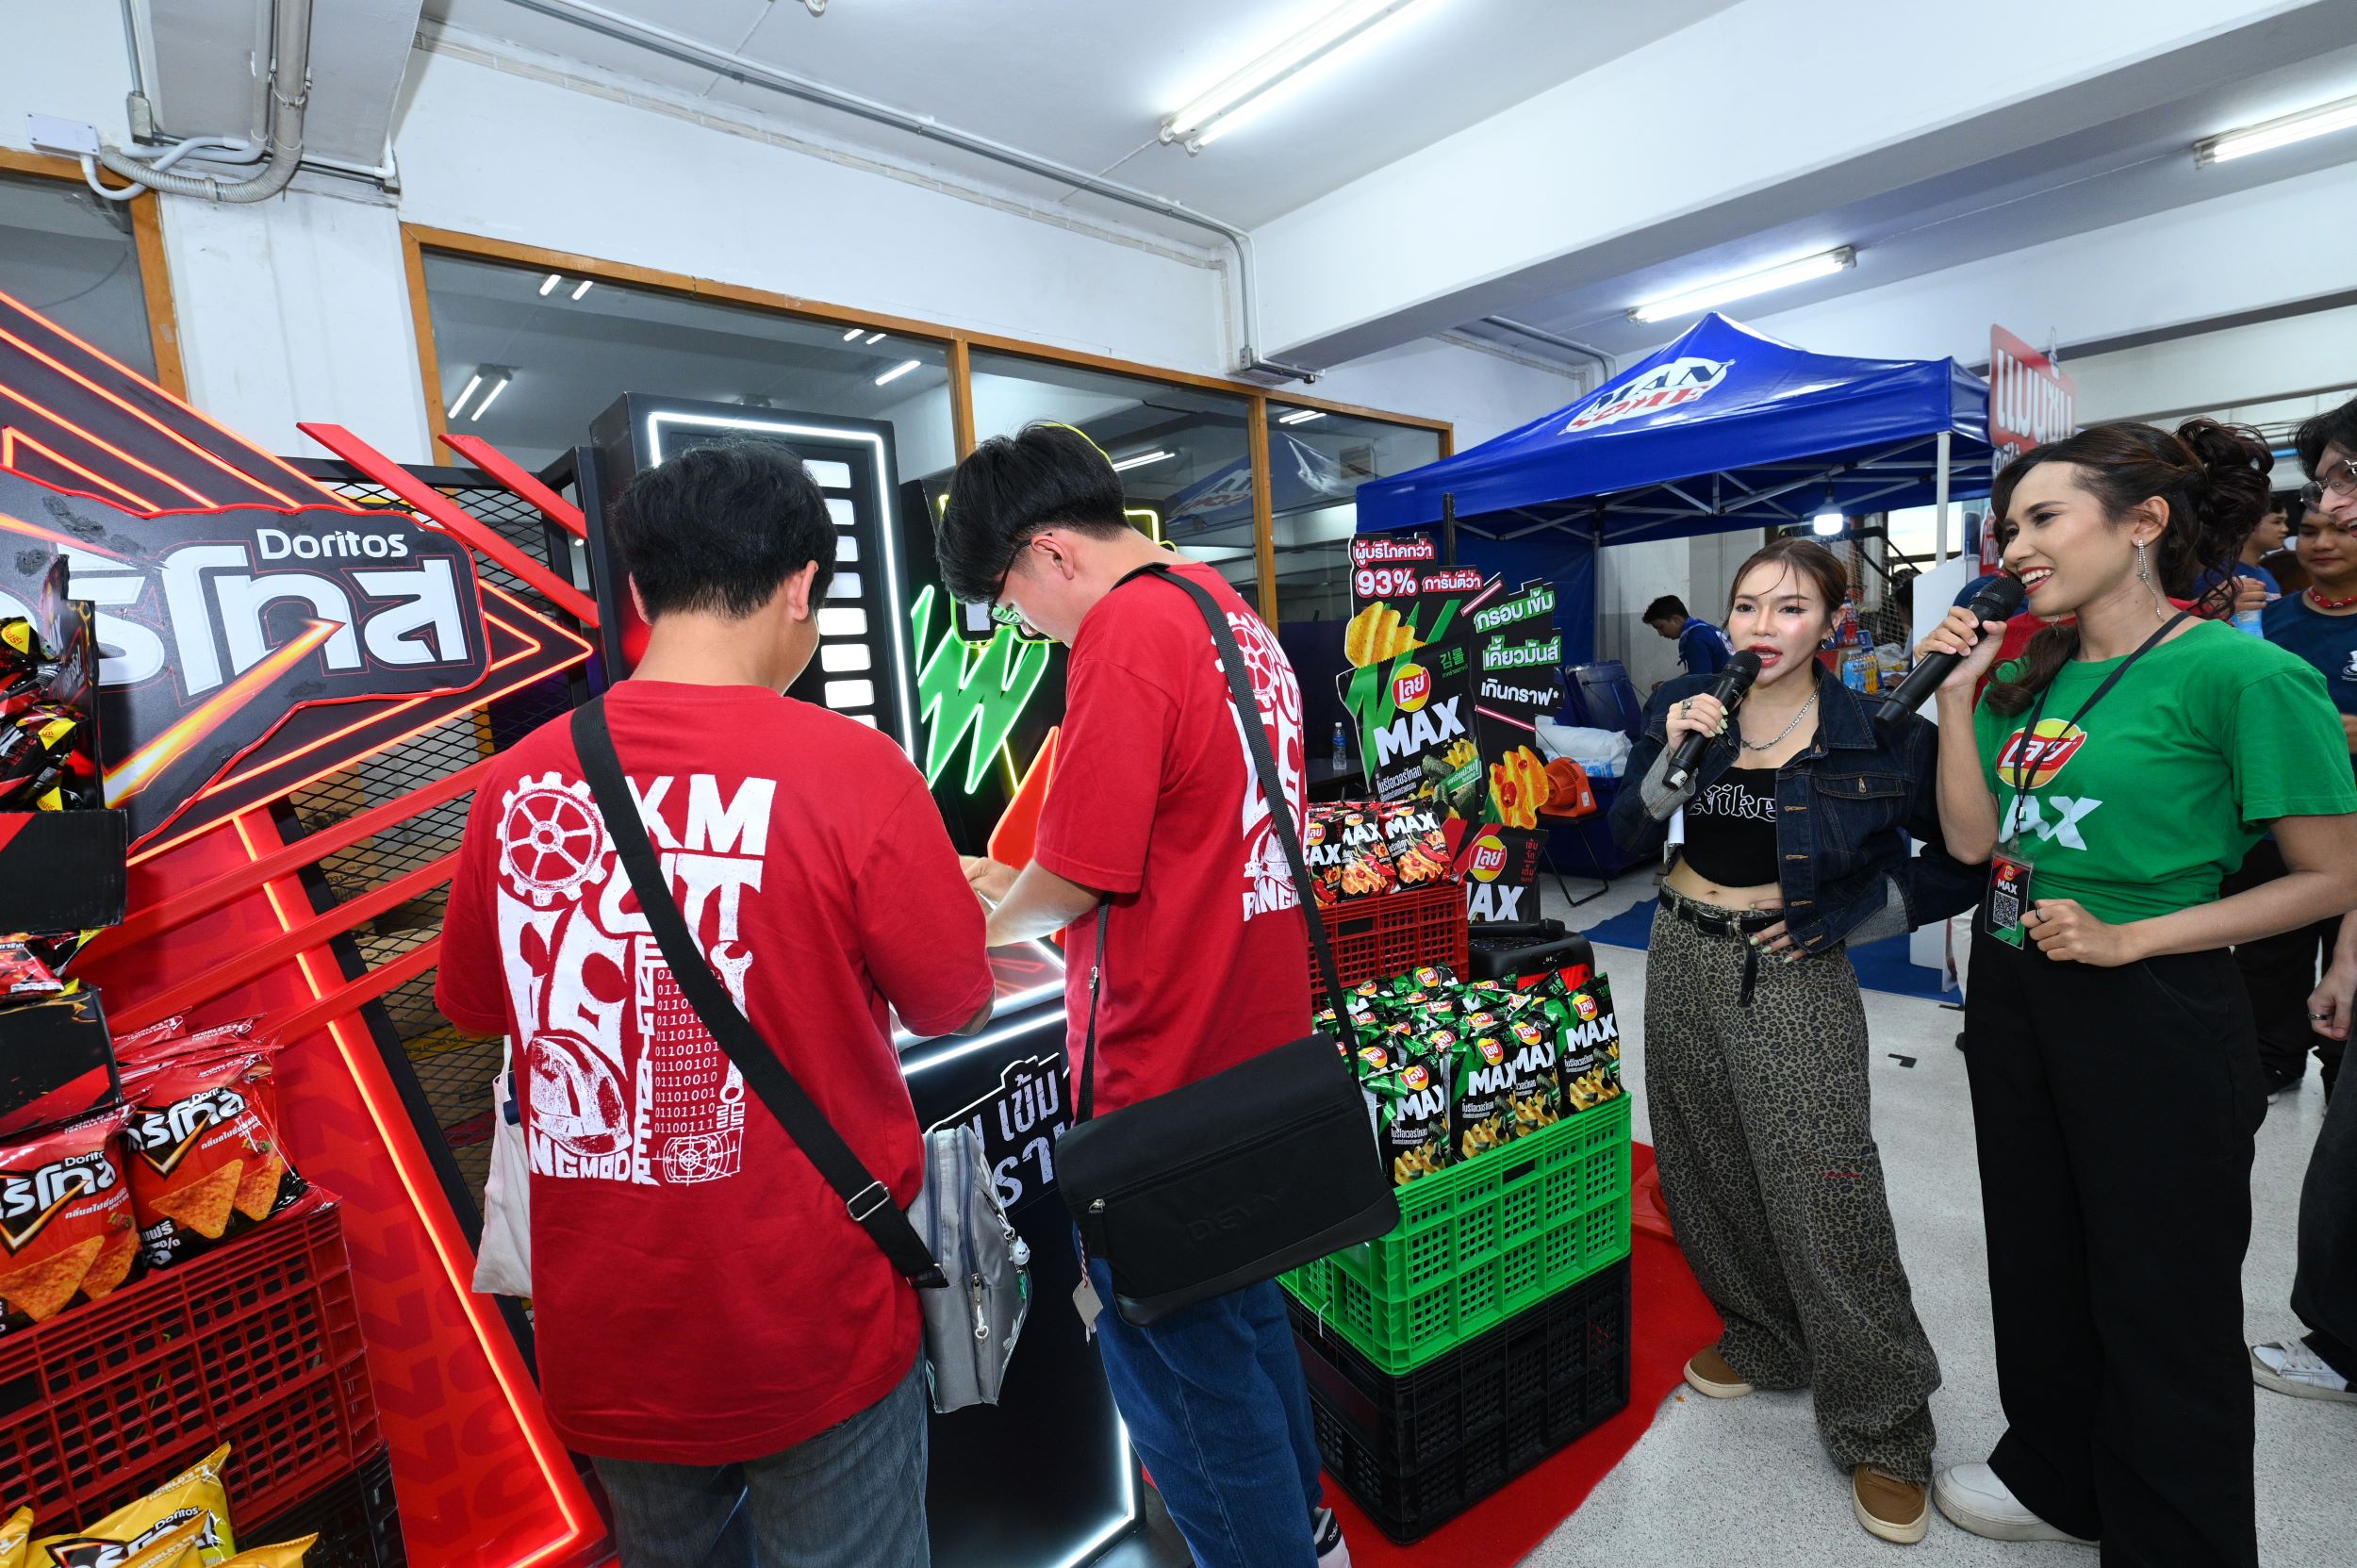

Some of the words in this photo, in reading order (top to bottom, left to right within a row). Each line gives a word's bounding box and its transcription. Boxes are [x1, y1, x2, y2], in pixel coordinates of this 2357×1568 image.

[1586, 364, 1725, 414] MAN
[256, 528, 409, 561] Doritos
[1355, 540, 1432, 565] ผู้บริโภคกว่า
[1358, 569, 1416, 596] 93%
[1425, 571, 1481, 591] การันตีว่า
[1477, 603, 1524, 631] กรอบ
[1526, 590, 1554, 619] เข้ม
[1485, 635, 1560, 668] เคี้ยวมันส์
[1374, 695, 1466, 767] MAX
[625, 773, 777, 857] KM
[1385, 812, 1439, 839] MAX
[1999, 795, 2103, 850] AX
[1310, 844, 1342, 866] AX
[1997, 879, 2018, 895] MAX
[1467, 883, 1525, 921] AX
[1566, 1014, 1618, 1052] MAX
[655, 1041, 719, 1057] 01100101
[655, 1057, 718, 1072] 01100101
[654, 1072, 717, 1087] 01110010
[192, 1087, 219, 1103] Dorit
[655, 1087, 717, 1102] 01101001
[997, 1068, 1059, 1142] เข้ม
[654, 1102, 716, 1118] 01101110
[654, 1118, 714, 1133] 01100111
[65, 1150, 105, 1167] Dorito
[530, 1122, 634, 1180] NGMOD
[0, 1159, 117, 1219] ริโทส
[154, 1506, 200, 1532] Doritos
